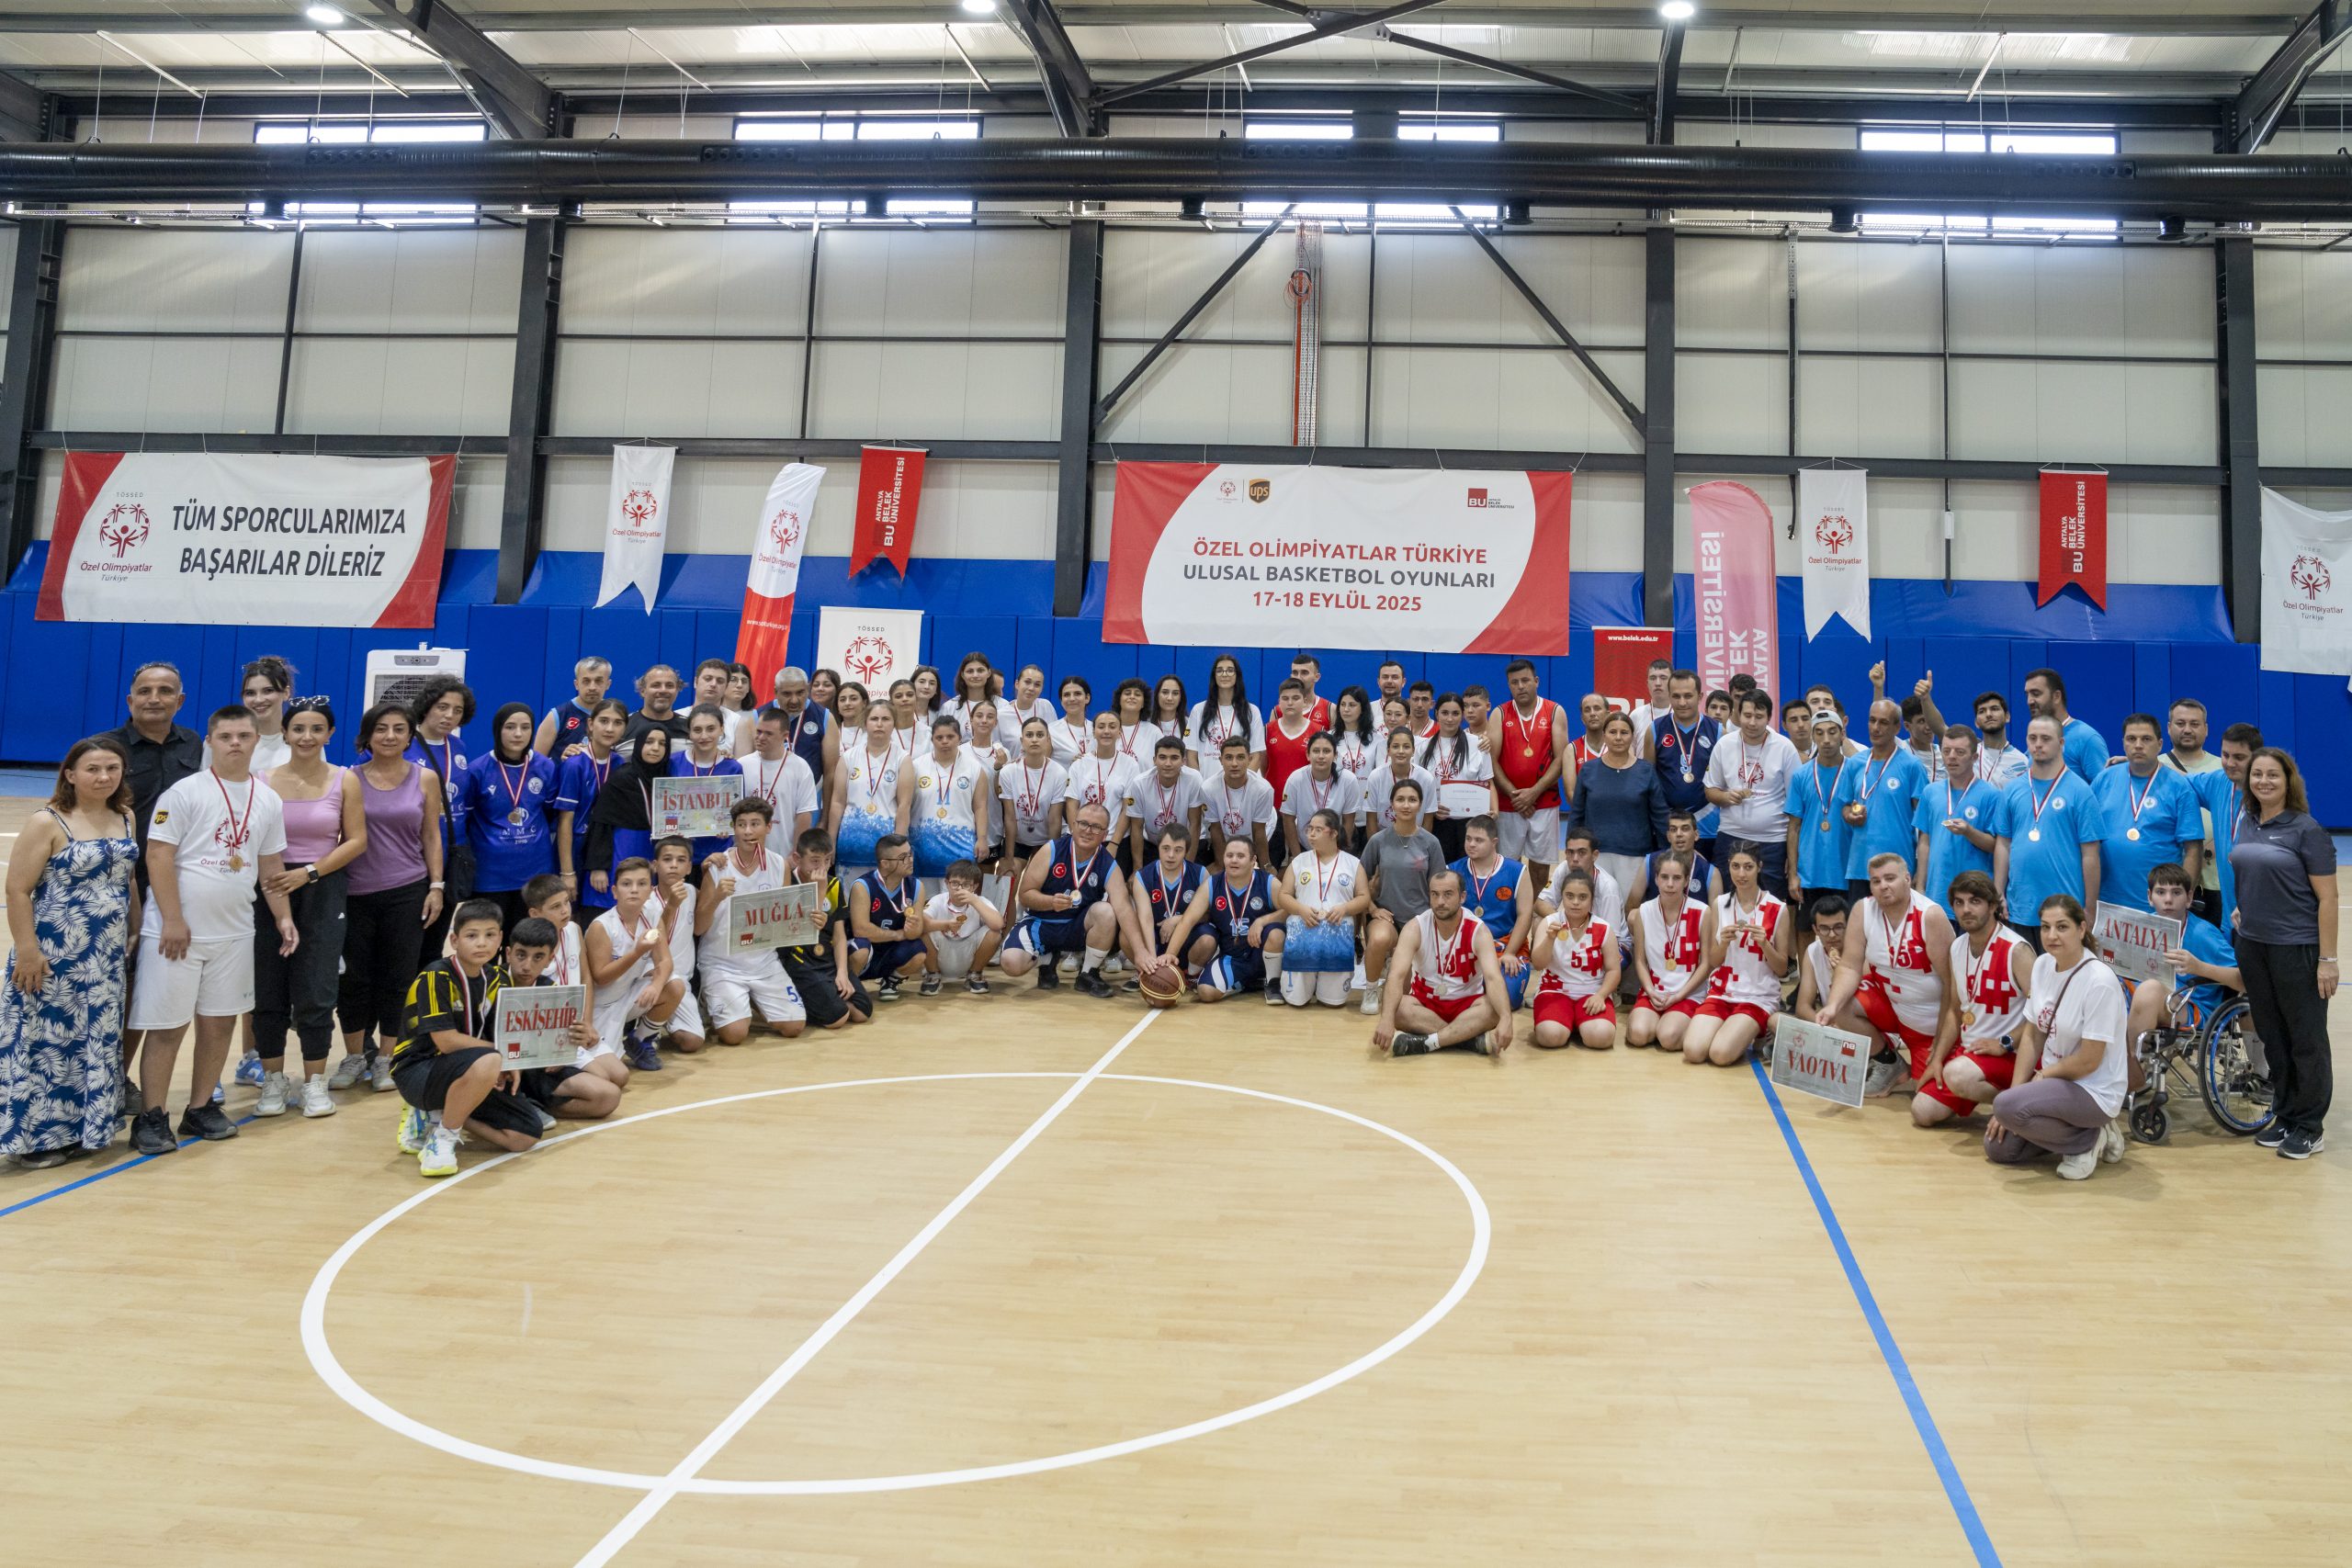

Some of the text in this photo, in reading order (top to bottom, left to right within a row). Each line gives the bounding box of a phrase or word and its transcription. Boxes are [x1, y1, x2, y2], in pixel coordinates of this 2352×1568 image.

[889, 457, 905, 523] ÜNİVERSİTESİ
[1250, 486, 1269, 501] ups
[876, 490, 884, 522] ANTALYA
[882, 491, 892, 523] BELEK
[1469, 498, 1487, 506] BU
[173, 498, 406, 534] TÜM SPORCULARIMIZA
[2076, 480, 2086, 549] ÜNİVERSİTESİ
[612, 527, 662, 538] Özel Olimpiyatlar
[884, 525, 895, 547] BU
[2068, 516, 2076, 549] BELEK
[1193, 536, 1487, 564] ÖZEL OLİMPİYATLAR TÜRKİYE
[1808, 556, 1862, 566] Özel Olimpiyatlar
[80, 560, 153, 574] Özel Olimpiyatlar
[179, 544, 386, 581] BAŞARILAR DİLERİZ
[2073, 551, 2083, 573] BU
[100, 574, 129, 582] Türkiye
[1183, 564, 1495, 588] ULUSAL BASKETBOL OYUNLARI
[1253, 590, 1422, 612] 17-18 EYLÜL 2025
[2283, 599, 2344, 615] Özel Olimpiyatlar
[2301, 613, 2324, 621] Türkiye
[662, 790, 734, 810] İSTANBUL
[744, 901, 804, 927] MUĞLA
[2100, 918, 2168, 953] ANTALYA
[1571, 950, 1583, 968] 5
[2103, 955, 2114, 964] BU
[505, 1000, 578, 1037] ESKİŞEHİR
[508, 1051, 520, 1059] BU
[1842, 1041, 1856, 1050] BU
[1788, 1048, 1848, 1085] YALOVA
